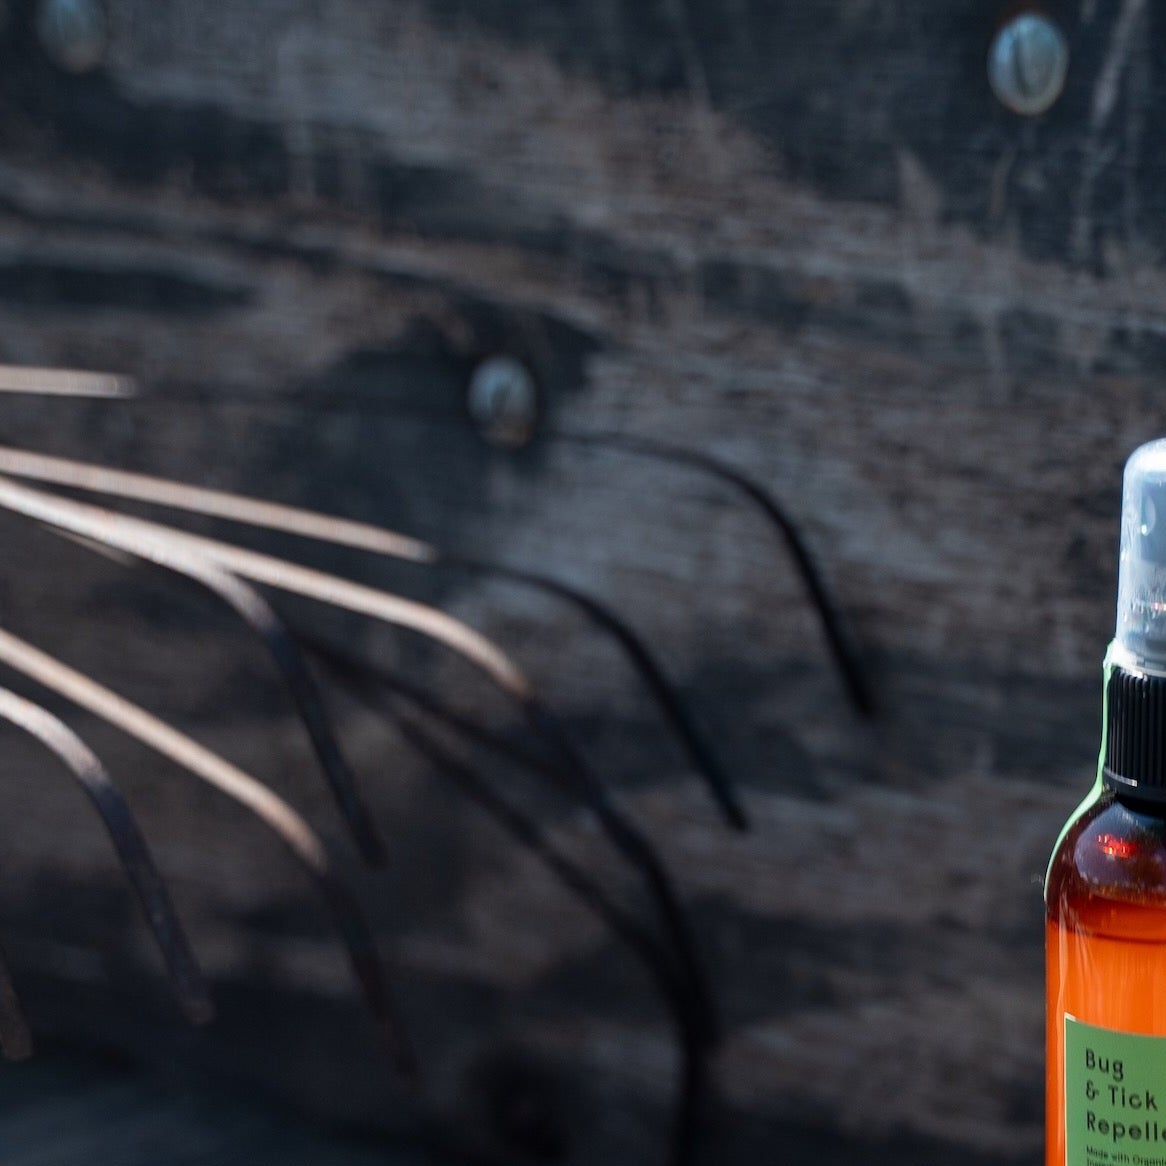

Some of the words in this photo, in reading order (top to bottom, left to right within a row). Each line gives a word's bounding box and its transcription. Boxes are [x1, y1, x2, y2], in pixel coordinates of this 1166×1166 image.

[1085, 1048, 1124, 1081] Bug
[1086, 1080, 1100, 1100] &
[1108, 1085, 1158, 1111] Tick
[1086, 1145, 1108, 1159] Made
[1112, 1152, 1130, 1164] with
